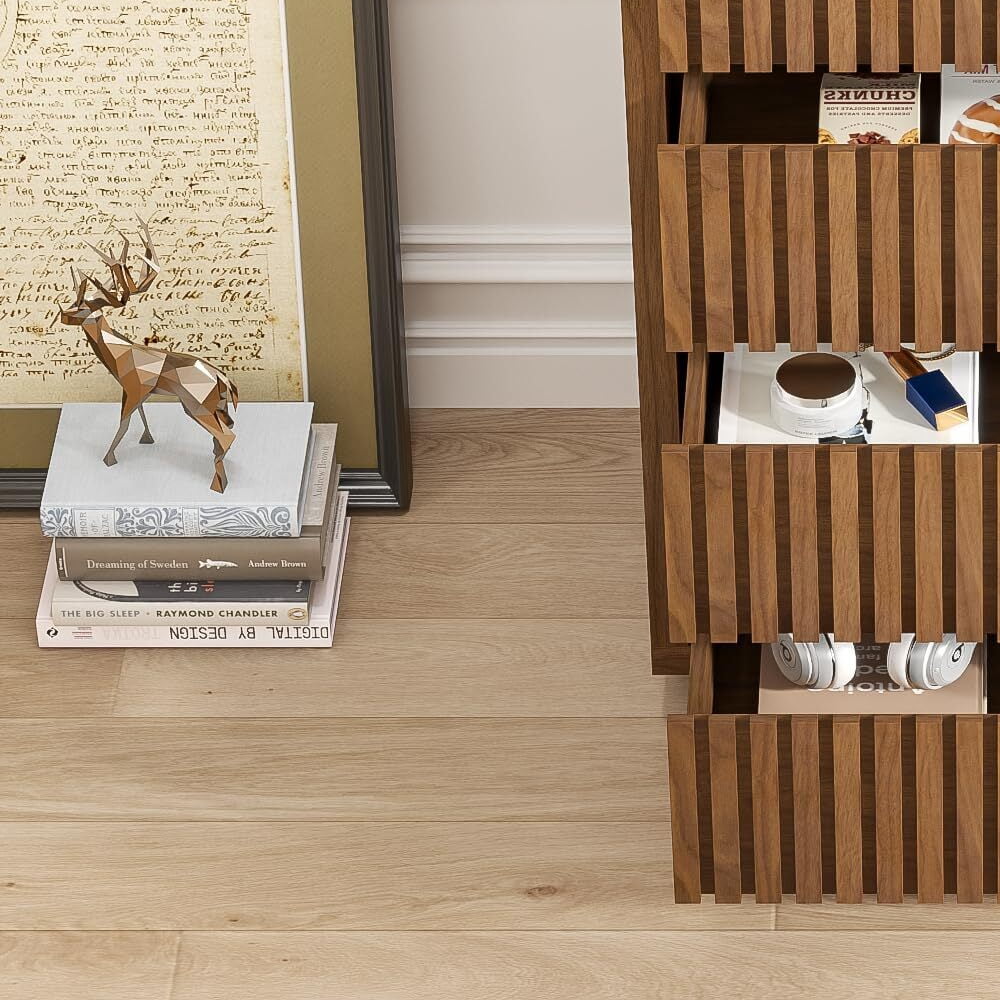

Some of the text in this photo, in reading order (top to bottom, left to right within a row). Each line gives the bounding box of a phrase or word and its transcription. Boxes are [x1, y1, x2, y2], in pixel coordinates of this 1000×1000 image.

[79, 512, 87, 537] EMOIR
[87, 559, 307, 570] Dreaming of Sweden Andrew Brown
[61, 609, 279, 618] THE BIG SLEEP RAYMOND CHANDLER
[169, 626, 227, 640] DESIGN
[239, 626, 256, 639] BY
[266, 626, 329, 639] DIGITAL
